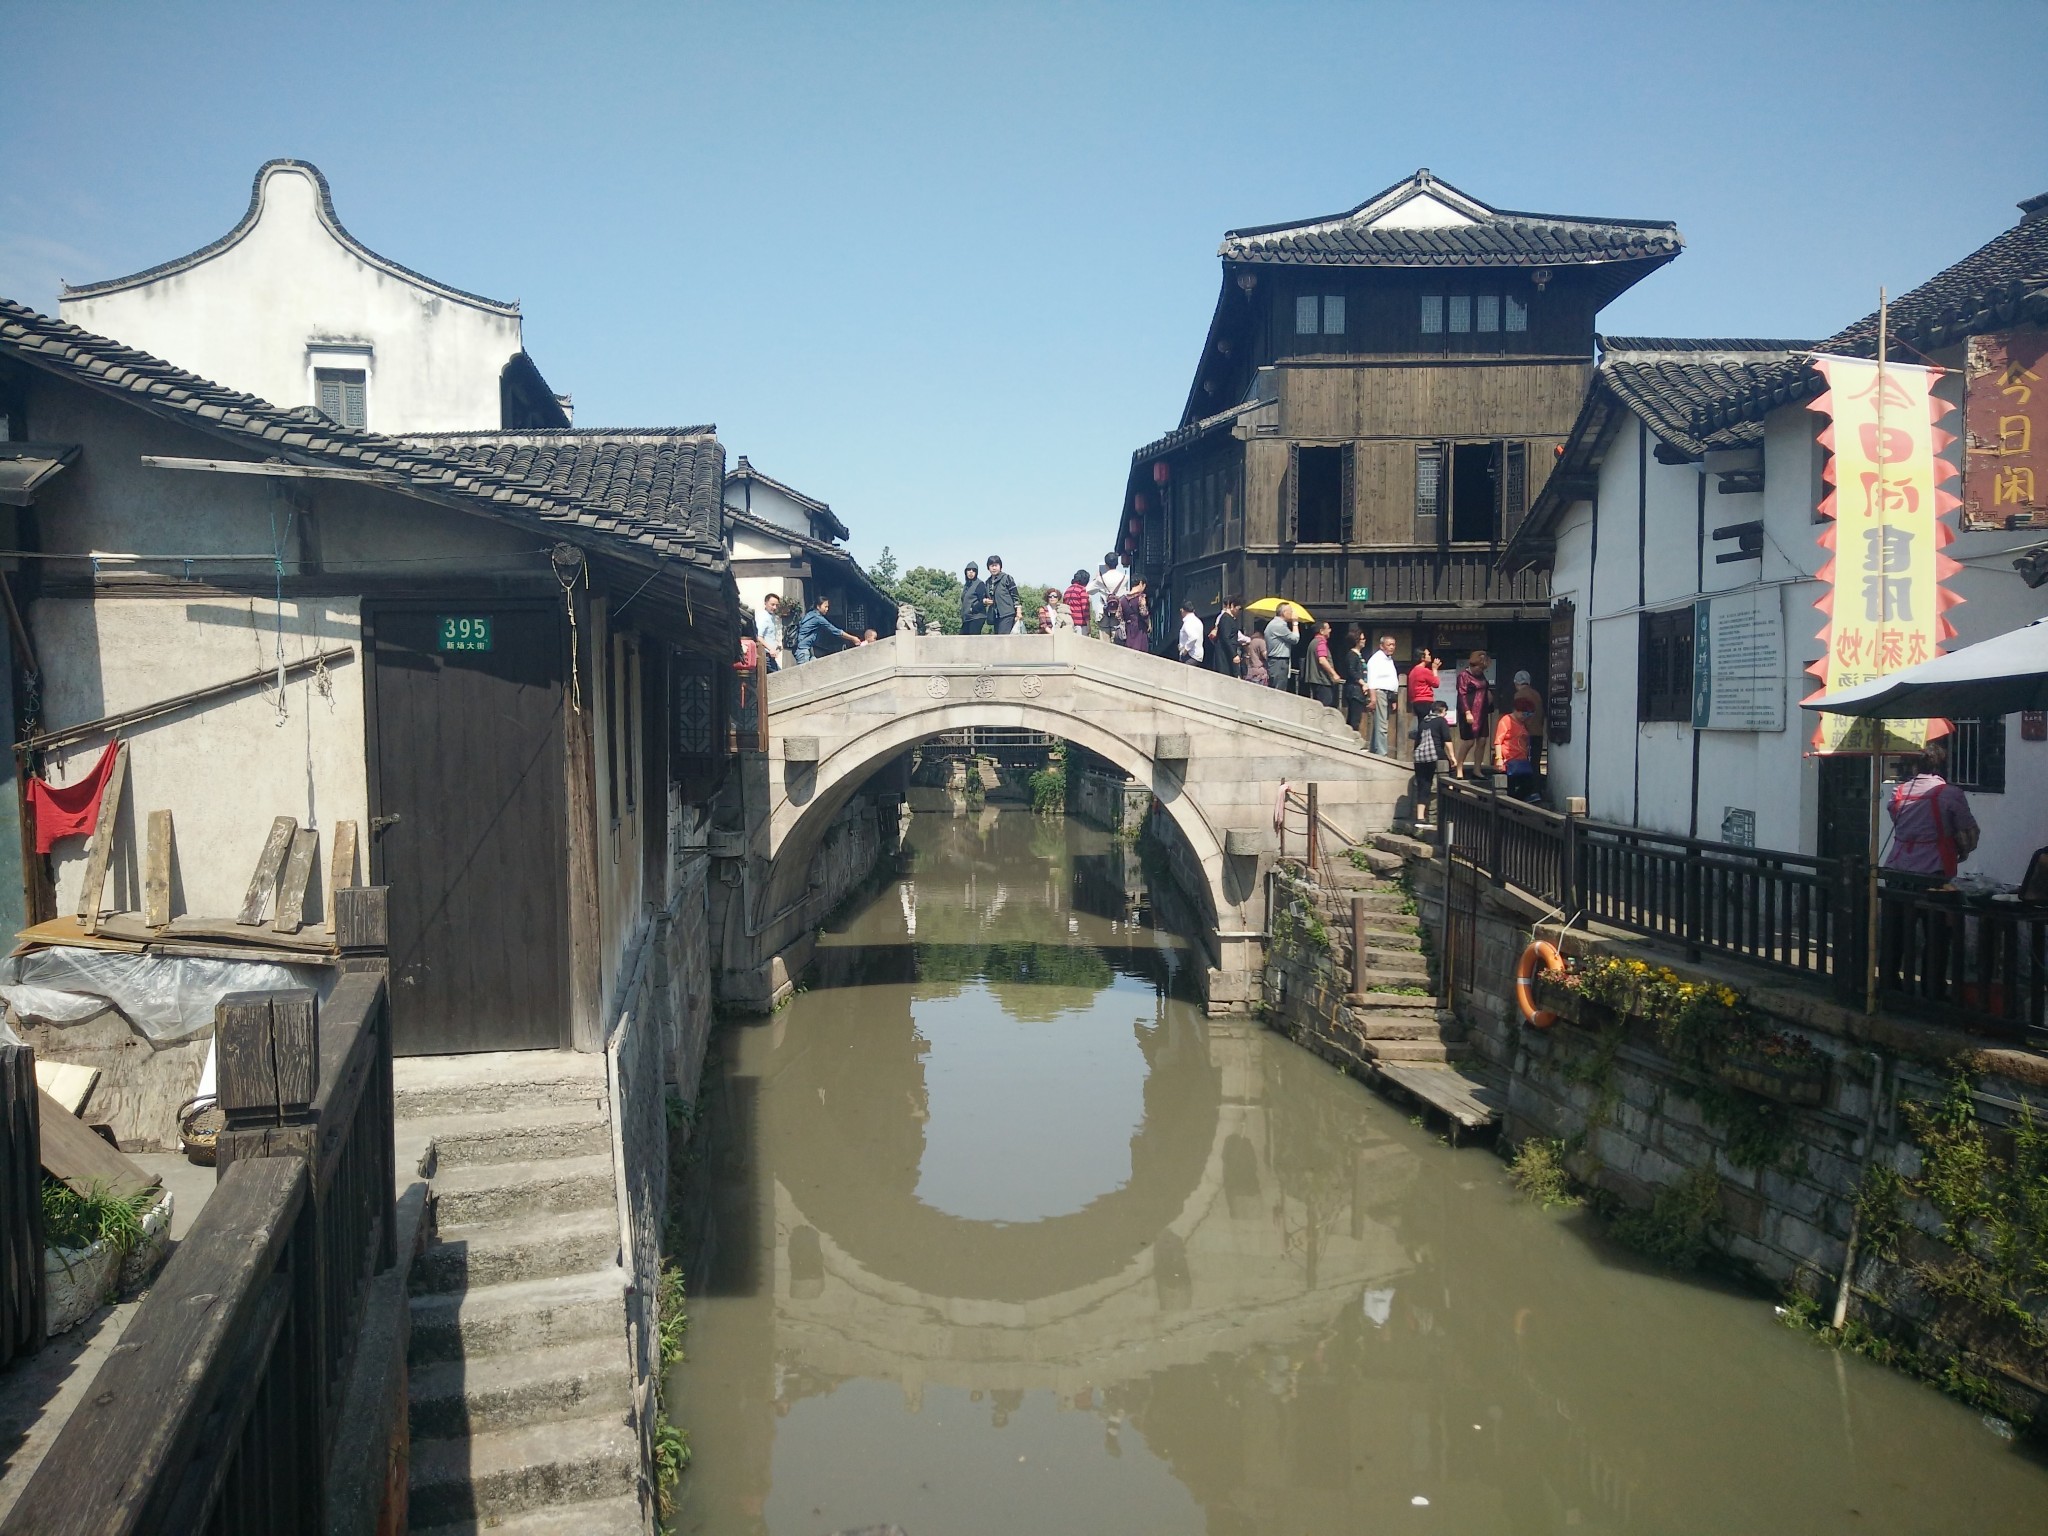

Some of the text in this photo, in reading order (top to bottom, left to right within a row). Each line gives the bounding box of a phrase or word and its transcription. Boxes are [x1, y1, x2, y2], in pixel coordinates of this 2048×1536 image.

[1994, 360, 2043, 505] 今日闲
[1352, 588, 1366, 597] 424
[445, 618, 486, 638] 395
[446, 641, 485, 650] 新场大街
